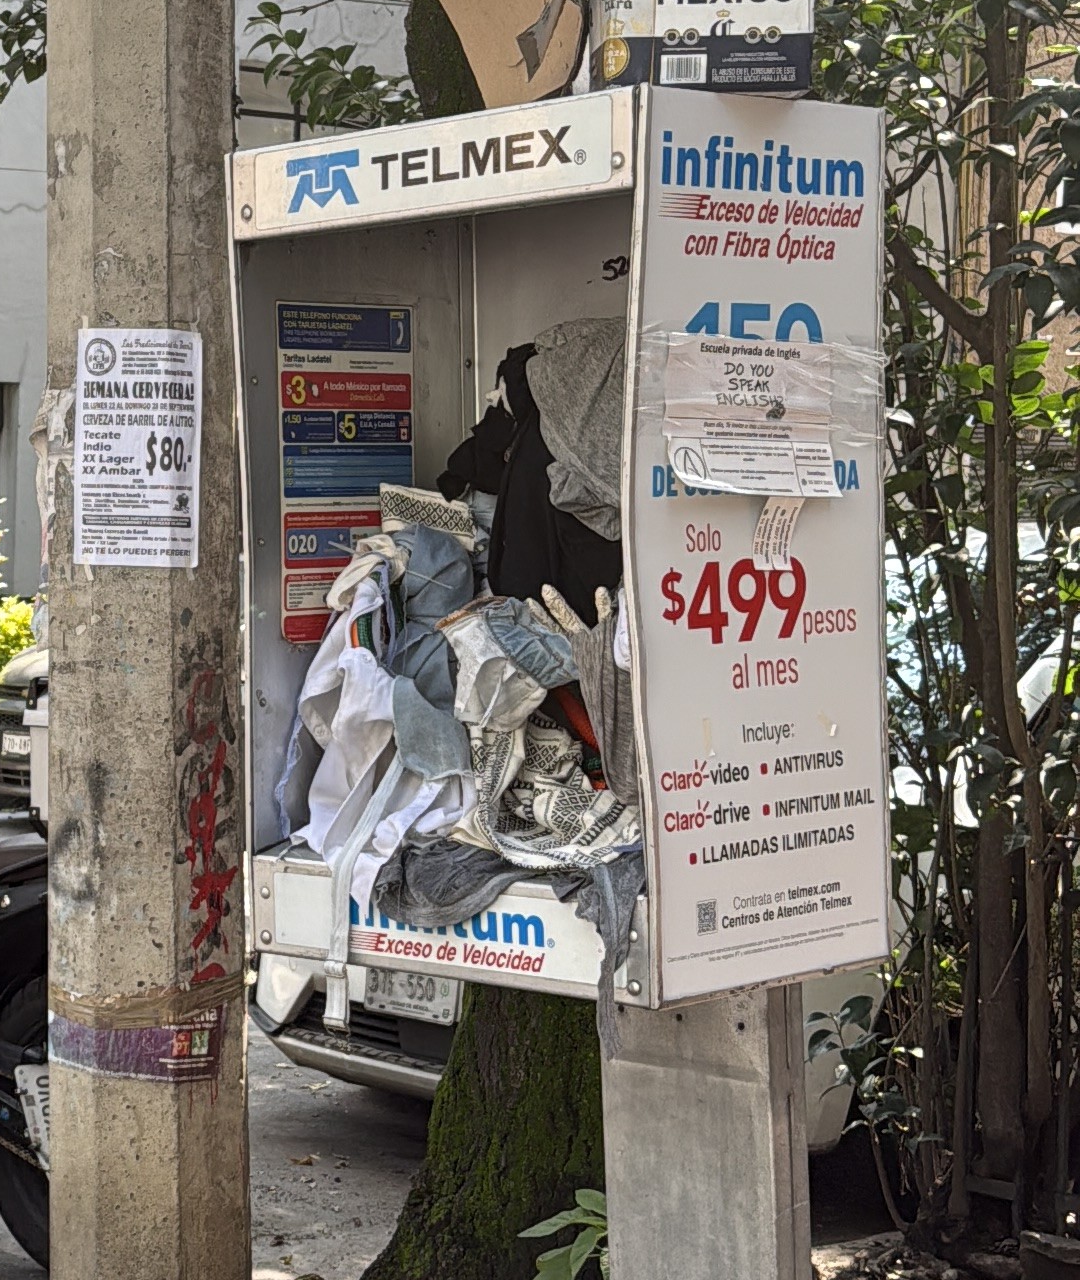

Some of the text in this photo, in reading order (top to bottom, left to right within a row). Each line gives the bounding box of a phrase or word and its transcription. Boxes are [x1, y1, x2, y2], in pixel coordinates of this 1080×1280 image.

[371, 125, 572, 190] TELMEX
[661, 131, 864, 197] infinitum
[695, 195, 864, 229] Exceso de Velocidad
[685, 228, 836, 264] con Fibra Óptica
[701, 342, 801, 360] Escuela privada de Inglés
[724, 363, 774, 378] DO YOU
[286, 375, 306, 405] $3
[728, 378, 770, 392] SPEAK
[108, 402, 116, 410] 22
[117, 402, 123, 410] AL
[83, 414, 113, 426] CERVEZA
[116, 414, 126, 426] DE
[128, 414, 155, 426] BARRIL
[157, 415, 168, 427] DE
[339, 413, 357, 439] $5
[83, 442, 112, 451] Indio
[84, 430, 121, 439] Tecate
[82, 453, 135, 465] XX Lager
[82, 465, 141, 475] XX Ambar
[652, 465, 678, 497] DE
[96, 547, 106, 555] TE
[108, 547, 120, 555] LO
[122, 547, 158, 556] PUEDES
[288, 534, 317, 554] 020
[686, 524, 721, 552] Solo
[661, 558, 856, 644] $499 pesos
[733, 653, 799, 690] al mes
[742, 722, 795, 745] Incluye:
[773, 750, 844, 775] ANTIVIRUS
[775, 793, 839, 818] INFINITUM
[843, 788, 875, 808] MAIL
[702, 824, 854, 864] LLAMADAS ILIMITADAS
[733, 881, 841, 910] Contrata en telmex.com
[721, 895, 853, 929] Centros de Atención Telmex
[375, 933, 545, 973] Exceso de Velocidad
